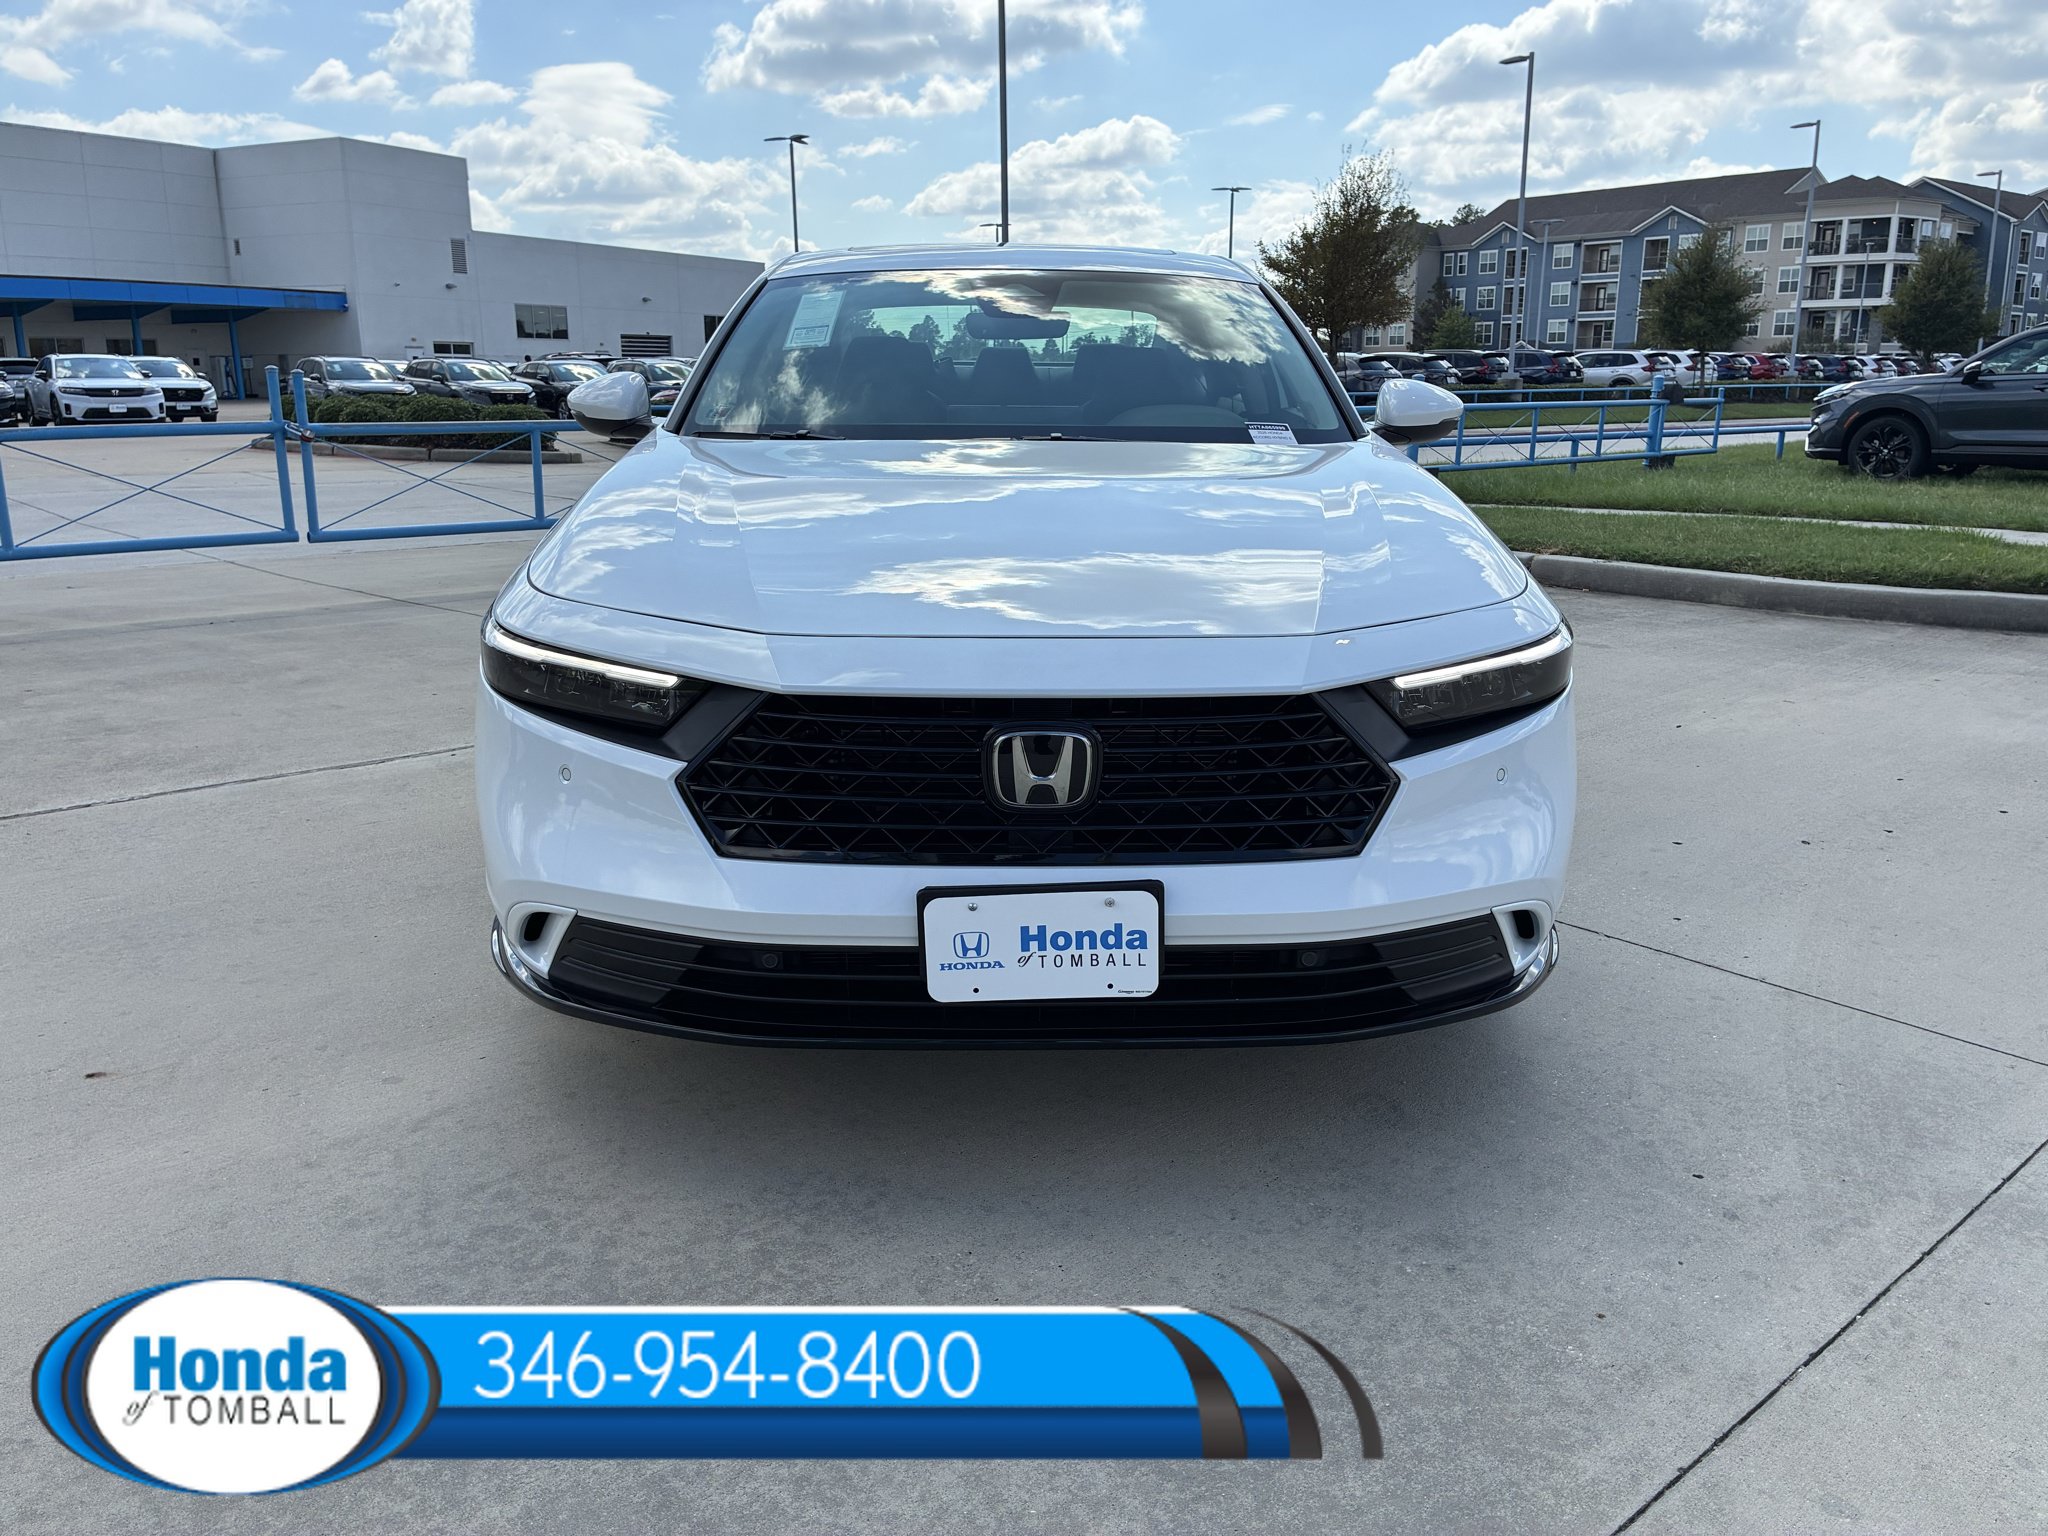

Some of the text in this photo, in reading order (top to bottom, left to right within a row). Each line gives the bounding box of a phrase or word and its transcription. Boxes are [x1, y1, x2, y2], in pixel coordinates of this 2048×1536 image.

[1019, 923, 1148, 952] Honda
[939, 960, 1005, 971] HONDA
[1017, 951, 1147, 968] of TOMBALL
